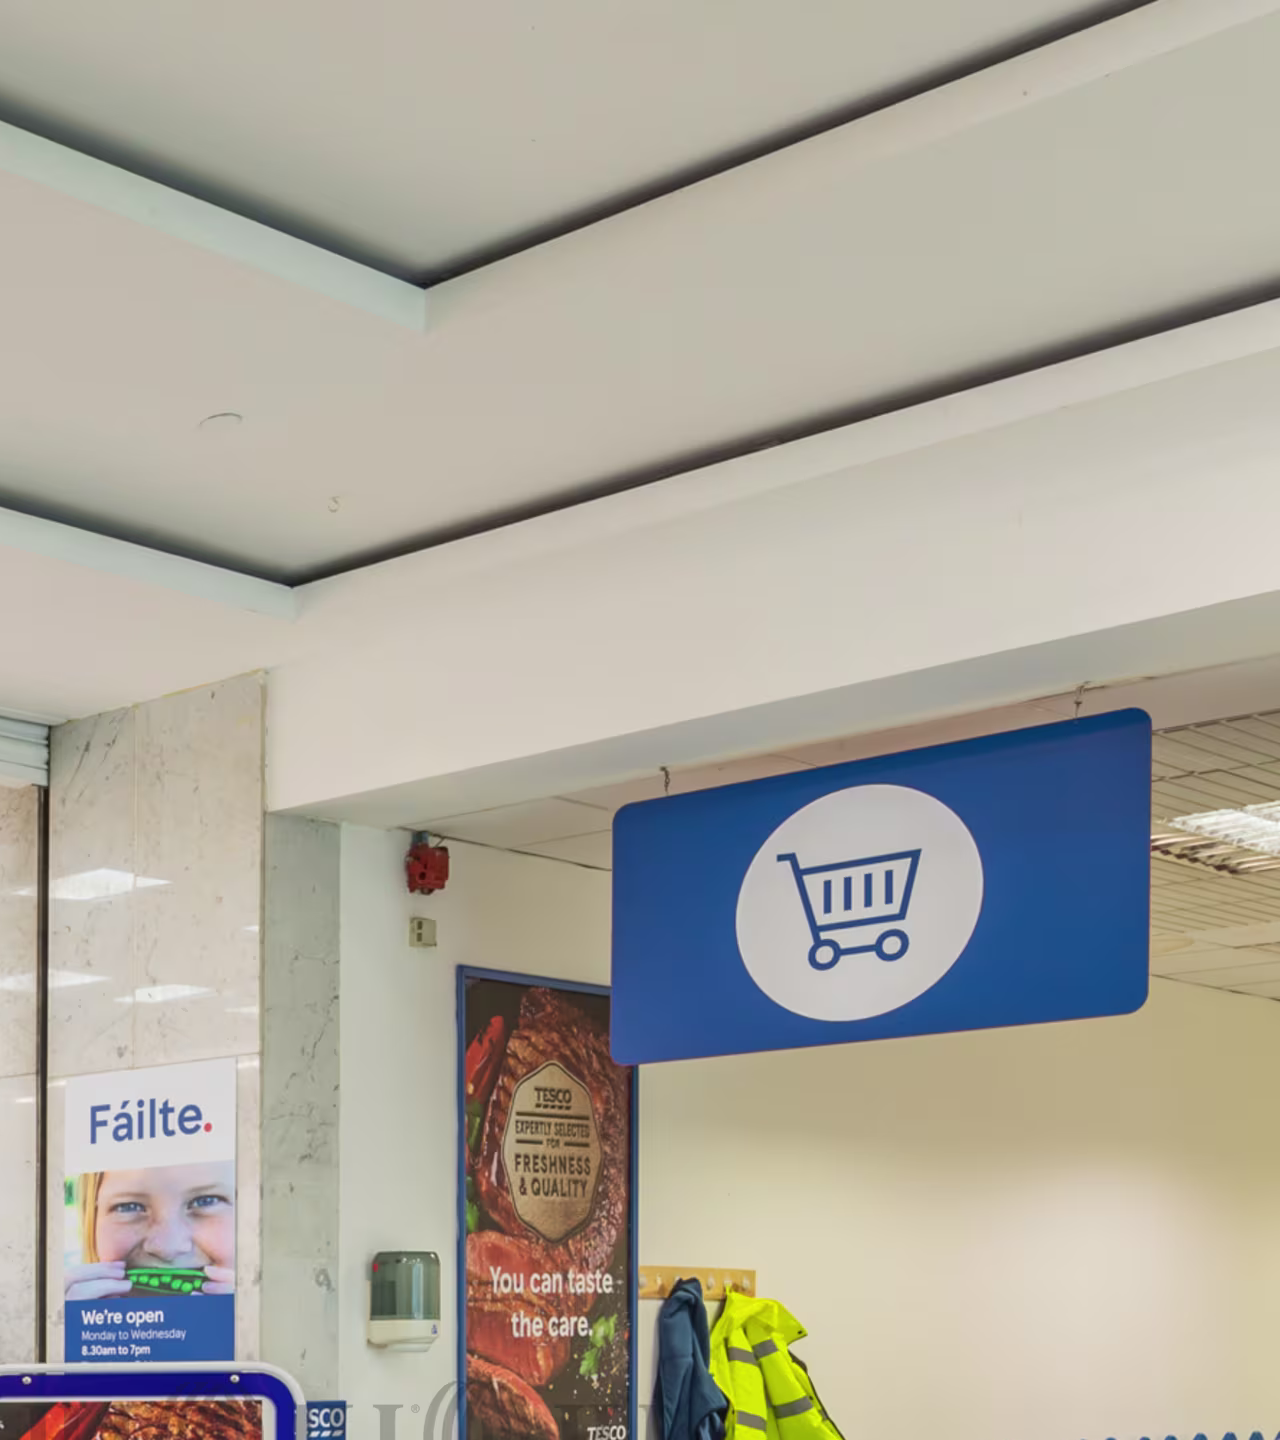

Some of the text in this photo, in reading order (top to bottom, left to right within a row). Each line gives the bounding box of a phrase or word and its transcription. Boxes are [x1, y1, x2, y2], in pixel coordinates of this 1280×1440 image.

[534, 1087, 572, 1104] TESCO
[90, 1098, 212, 1144] Fáilte.
[515, 1120, 590, 1138] EXPERTLY SELECTED
[546, 1139, 560, 1149] FOR
[514, 1154, 591, 1175] FRESHNESS
[519, 1176, 588, 1198] & QUALITY
[490, 1266, 613, 1294] You can taste
[81, 1310, 164, 1328] We're open
[511, 1310, 593, 1337] the care.
[81, 1328, 187, 1342] Monday to Wednesday
[81, 1344, 151, 1357] 8.30am to 7pm
[307, 1408, 345, 1428] SCO
